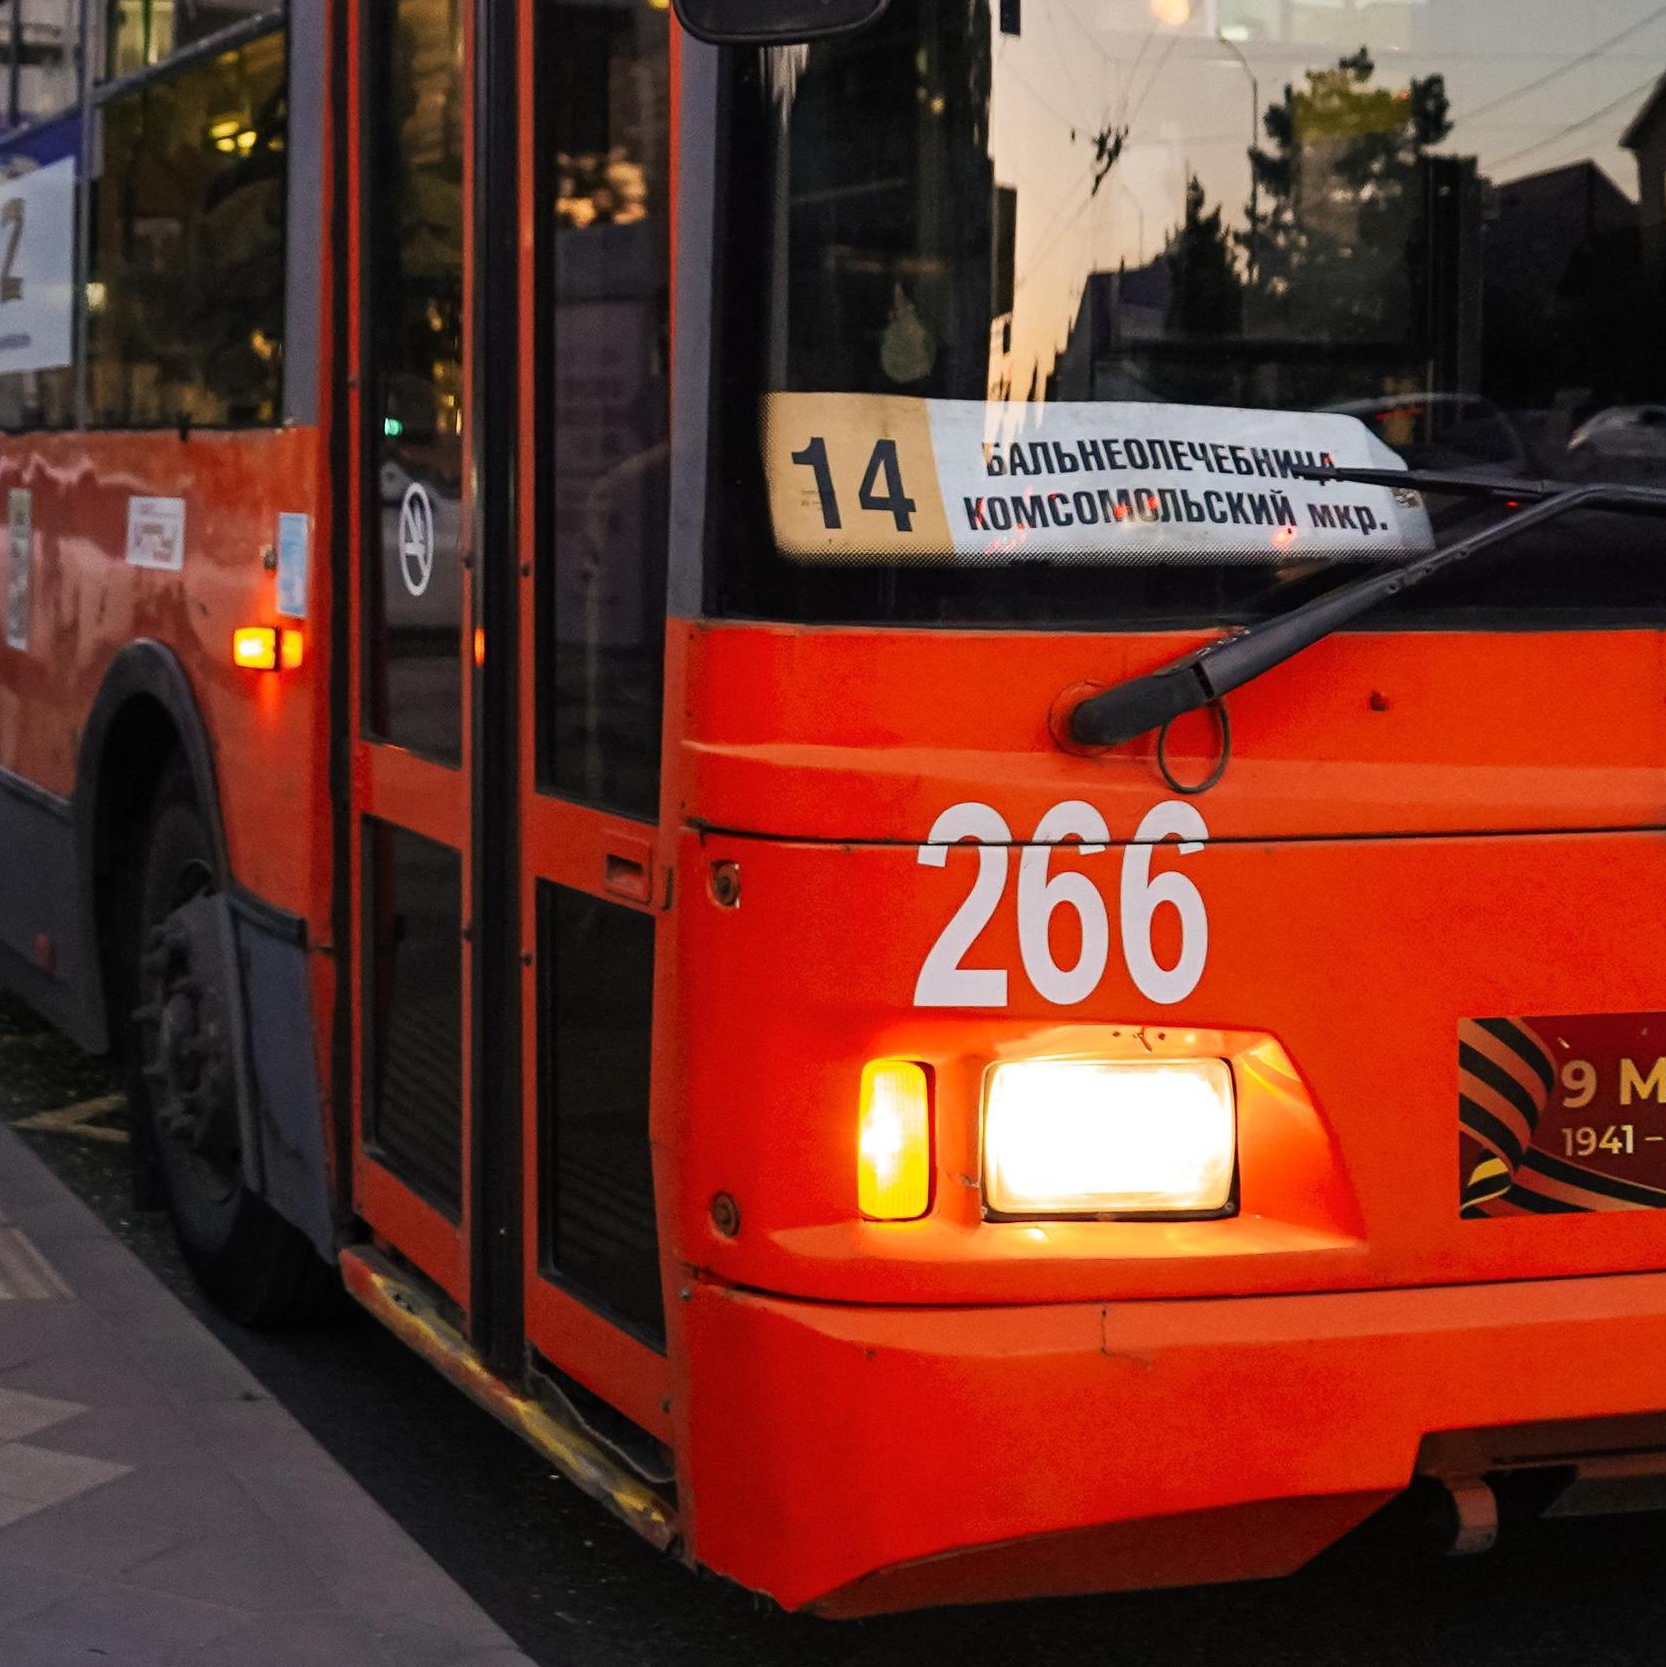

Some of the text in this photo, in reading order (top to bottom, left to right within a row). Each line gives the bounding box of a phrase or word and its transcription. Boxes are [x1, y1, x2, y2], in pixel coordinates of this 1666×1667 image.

[0, 197, 25, 304] 2
[791, 437, 917, 532] 14
[963, 488, 1388, 535] КОМСОМОЛЬСКИЙ мкр.
[913, 800, 1209, 1007] 266
[1561, 1060, 1597, 1108] 9
[1562, 1124, 1634, 1156] 1941
